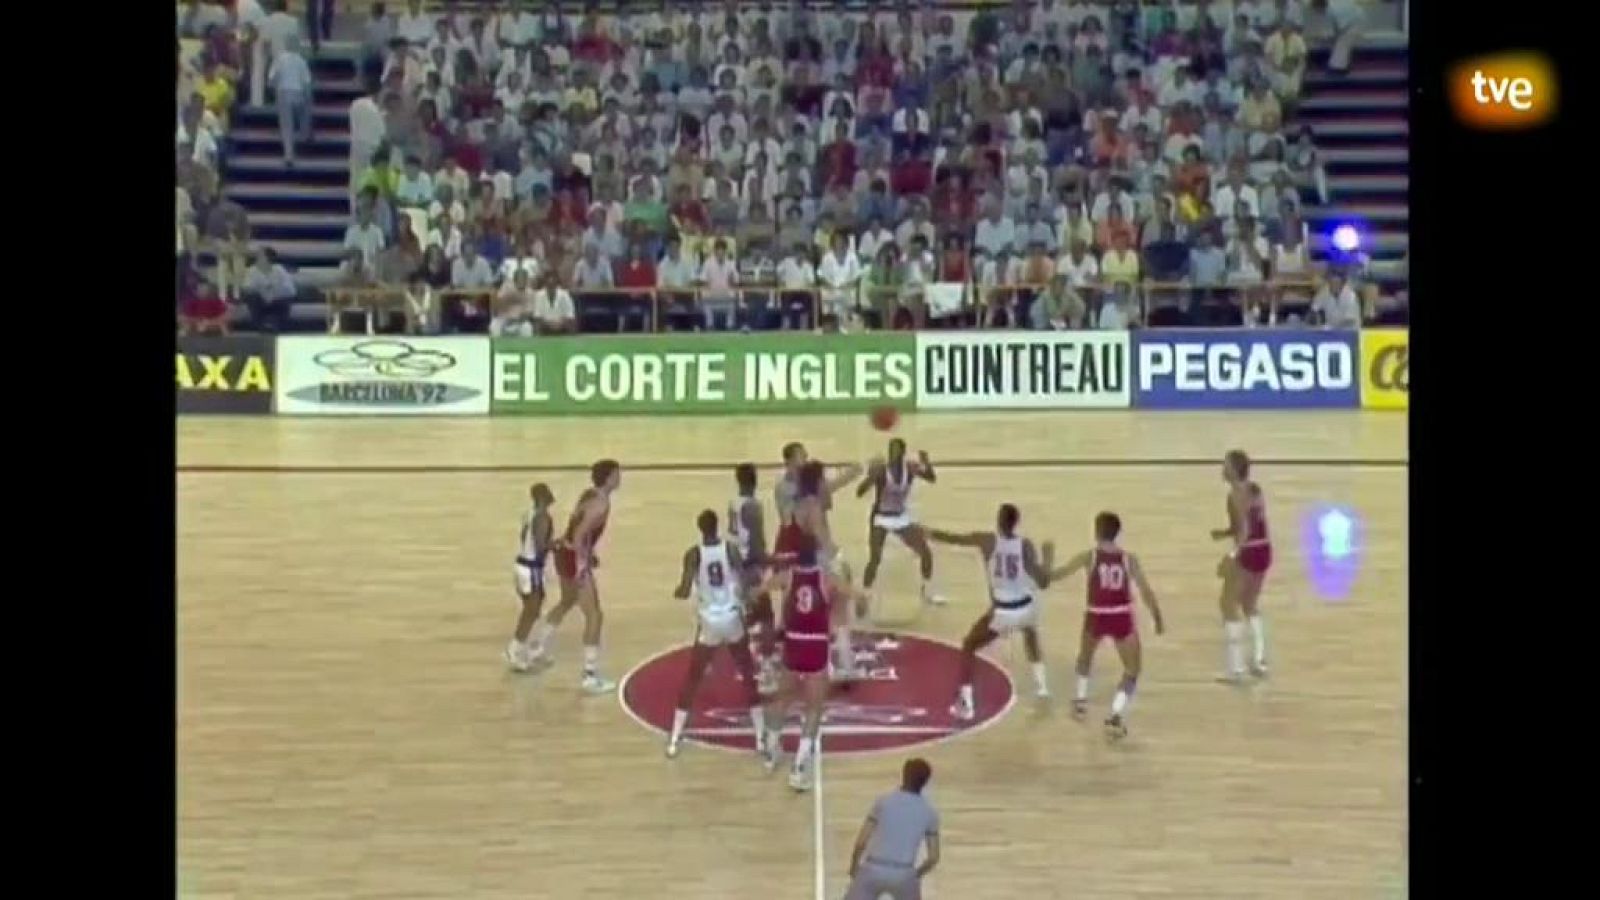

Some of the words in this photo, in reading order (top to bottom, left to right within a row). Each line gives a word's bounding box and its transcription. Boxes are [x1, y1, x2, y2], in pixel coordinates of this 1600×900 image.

[493, 353, 549, 400] EL
[565, 352, 727, 401] CORTE
[744, 352, 912, 400] INGLES
[924, 343, 1123, 395] COINTREAU
[1139, 342, 1352, 391] PEGASO
[1099, 562, 1124, 590] 10
